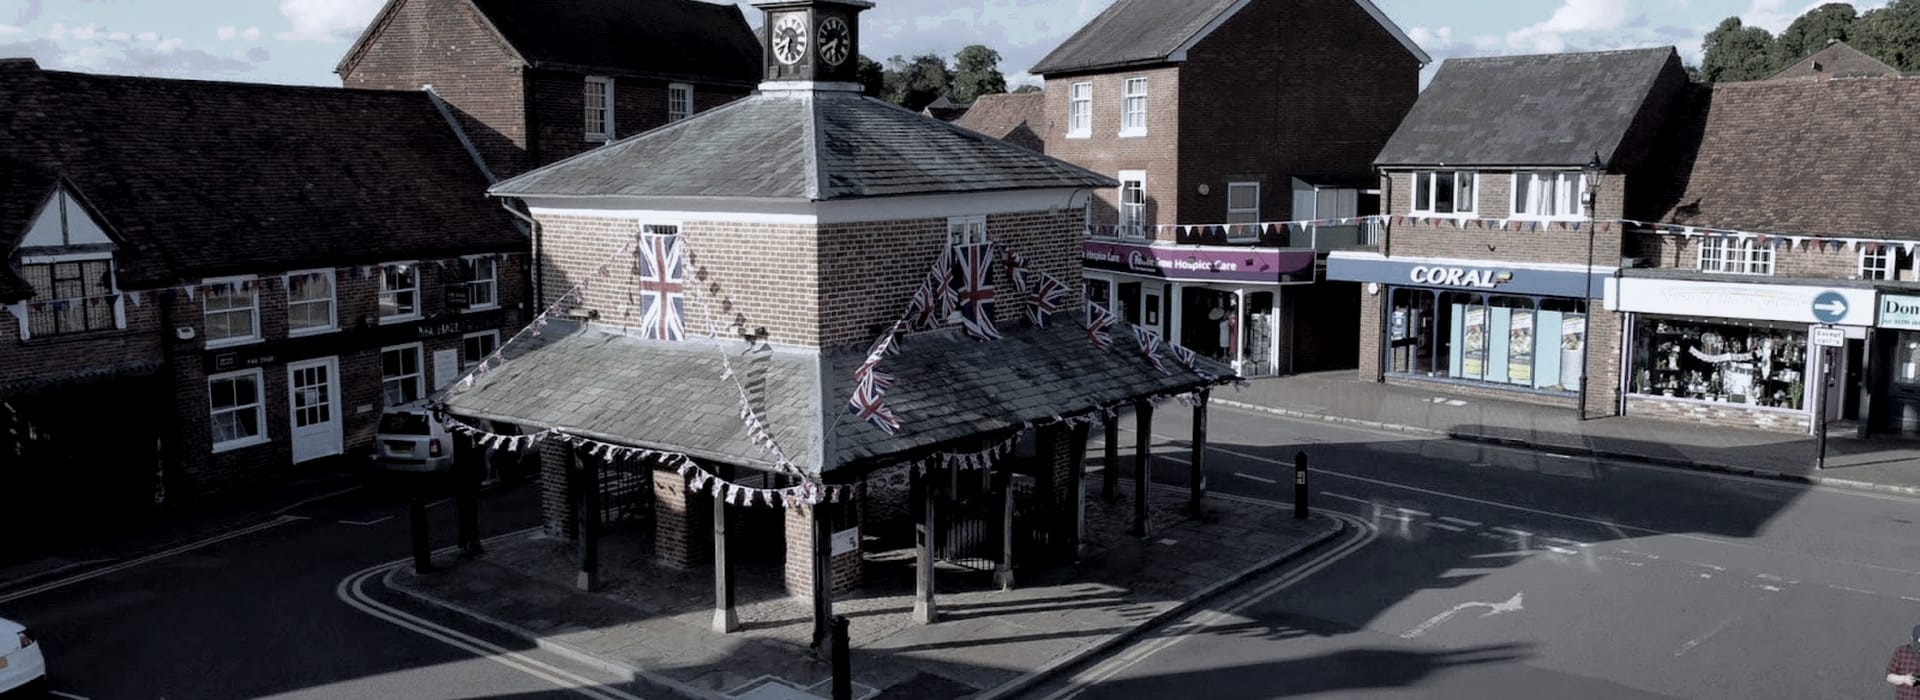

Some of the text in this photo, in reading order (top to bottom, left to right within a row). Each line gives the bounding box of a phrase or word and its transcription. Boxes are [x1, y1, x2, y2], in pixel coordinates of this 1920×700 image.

[1174, 259, 1212, 271] Hospice
[1214, 260, 1237, 271] Care
[1410, 266, 1496, 288] CORAL
